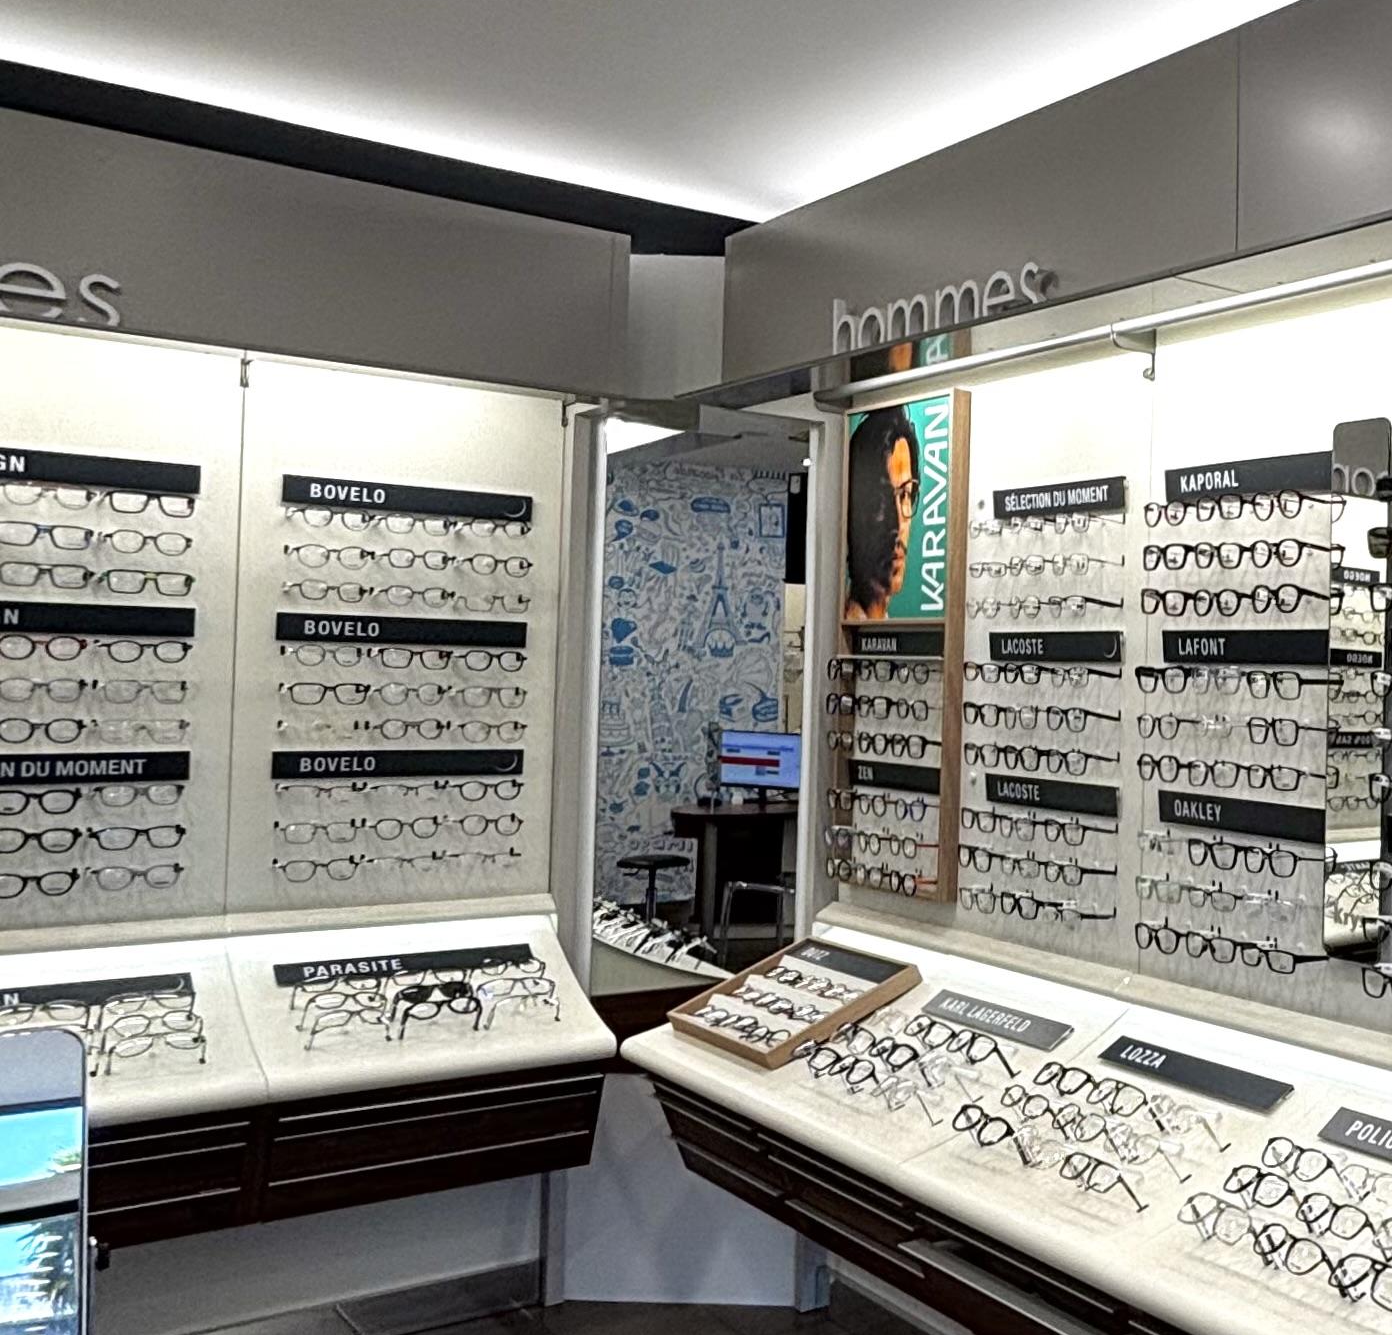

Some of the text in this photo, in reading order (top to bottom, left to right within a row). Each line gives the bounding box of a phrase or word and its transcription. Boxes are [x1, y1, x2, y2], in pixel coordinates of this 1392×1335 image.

[1179, 469, 1239, 493] KAPORAL
[309, 482, 387, 504] BOVELO
[1004, 484, 1109, 512] SÉLECTION DU MOMENT
[920, 403, 950, 612] KARAVAN
[303, 619, 380, 637] BOVELO
[861, 637, 897, 652] KARAVAN
[1001, 638, 1044, 655] LACOSTE
[1178, 637, 1226, 656] LAFONT
[20, 760, 51, 778] DU
[55, 758, 147, 777] MOMENT
[299, 756, 376, 773] BOVELO
[857, 765, 874, 781] ZEN
[997, 780, 1041, 801] LACOSTE
[1173, 800, 1222, 823] OAKLEY
[303, 958, 404, 979] PARASITE
[938, 996, 1032, 1033] KARL LAGERFELD
[1118, 1042, 1167, 1069] LOZZA
